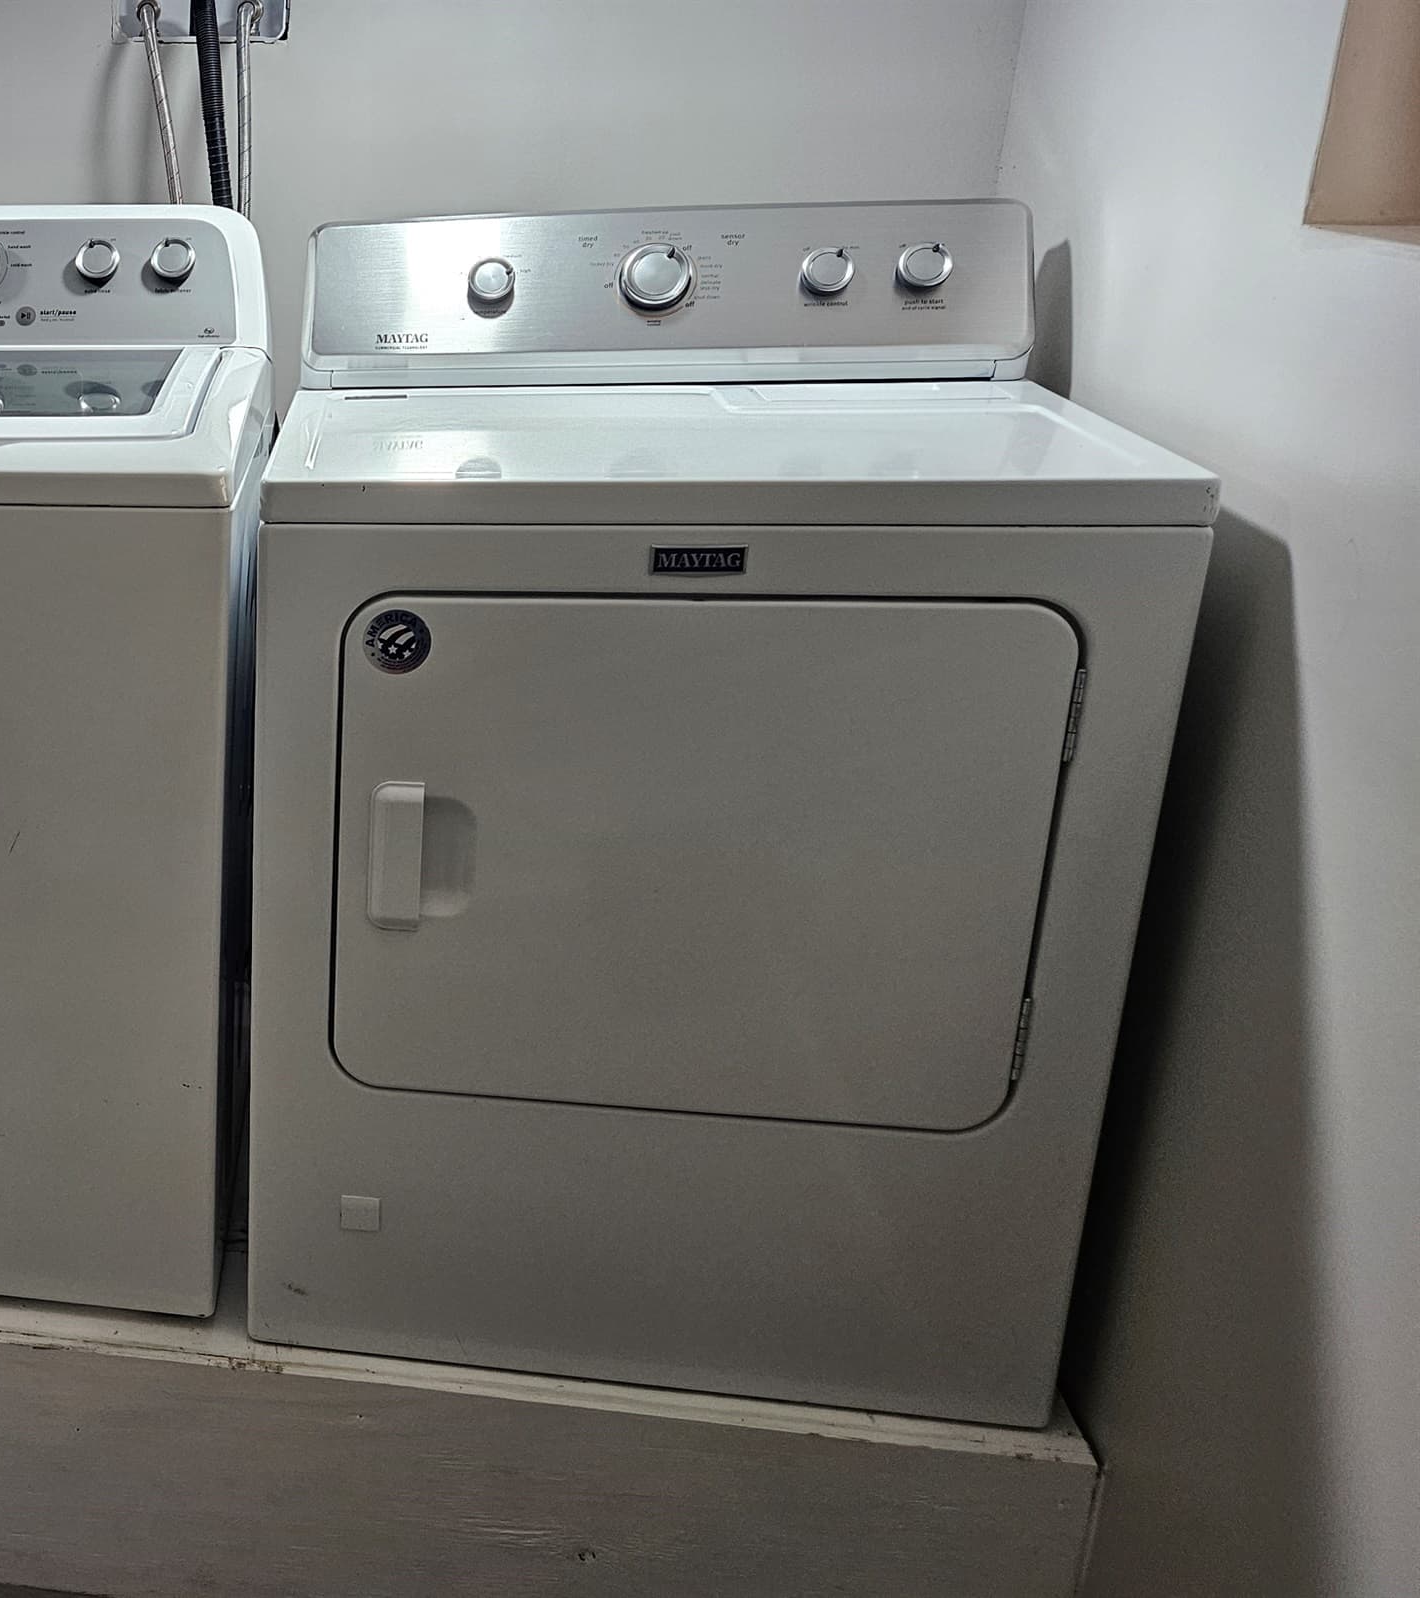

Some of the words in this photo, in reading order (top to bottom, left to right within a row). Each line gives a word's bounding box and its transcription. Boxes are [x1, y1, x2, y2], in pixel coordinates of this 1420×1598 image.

[604, 281, 614, 289] off
[40, 309, 76, 317] start/pause
[376, 333, 429, 344] MAYTAG
[657, 552, 741, 568] MAYTAG
[365, 612, 418, 648] AMERICA
